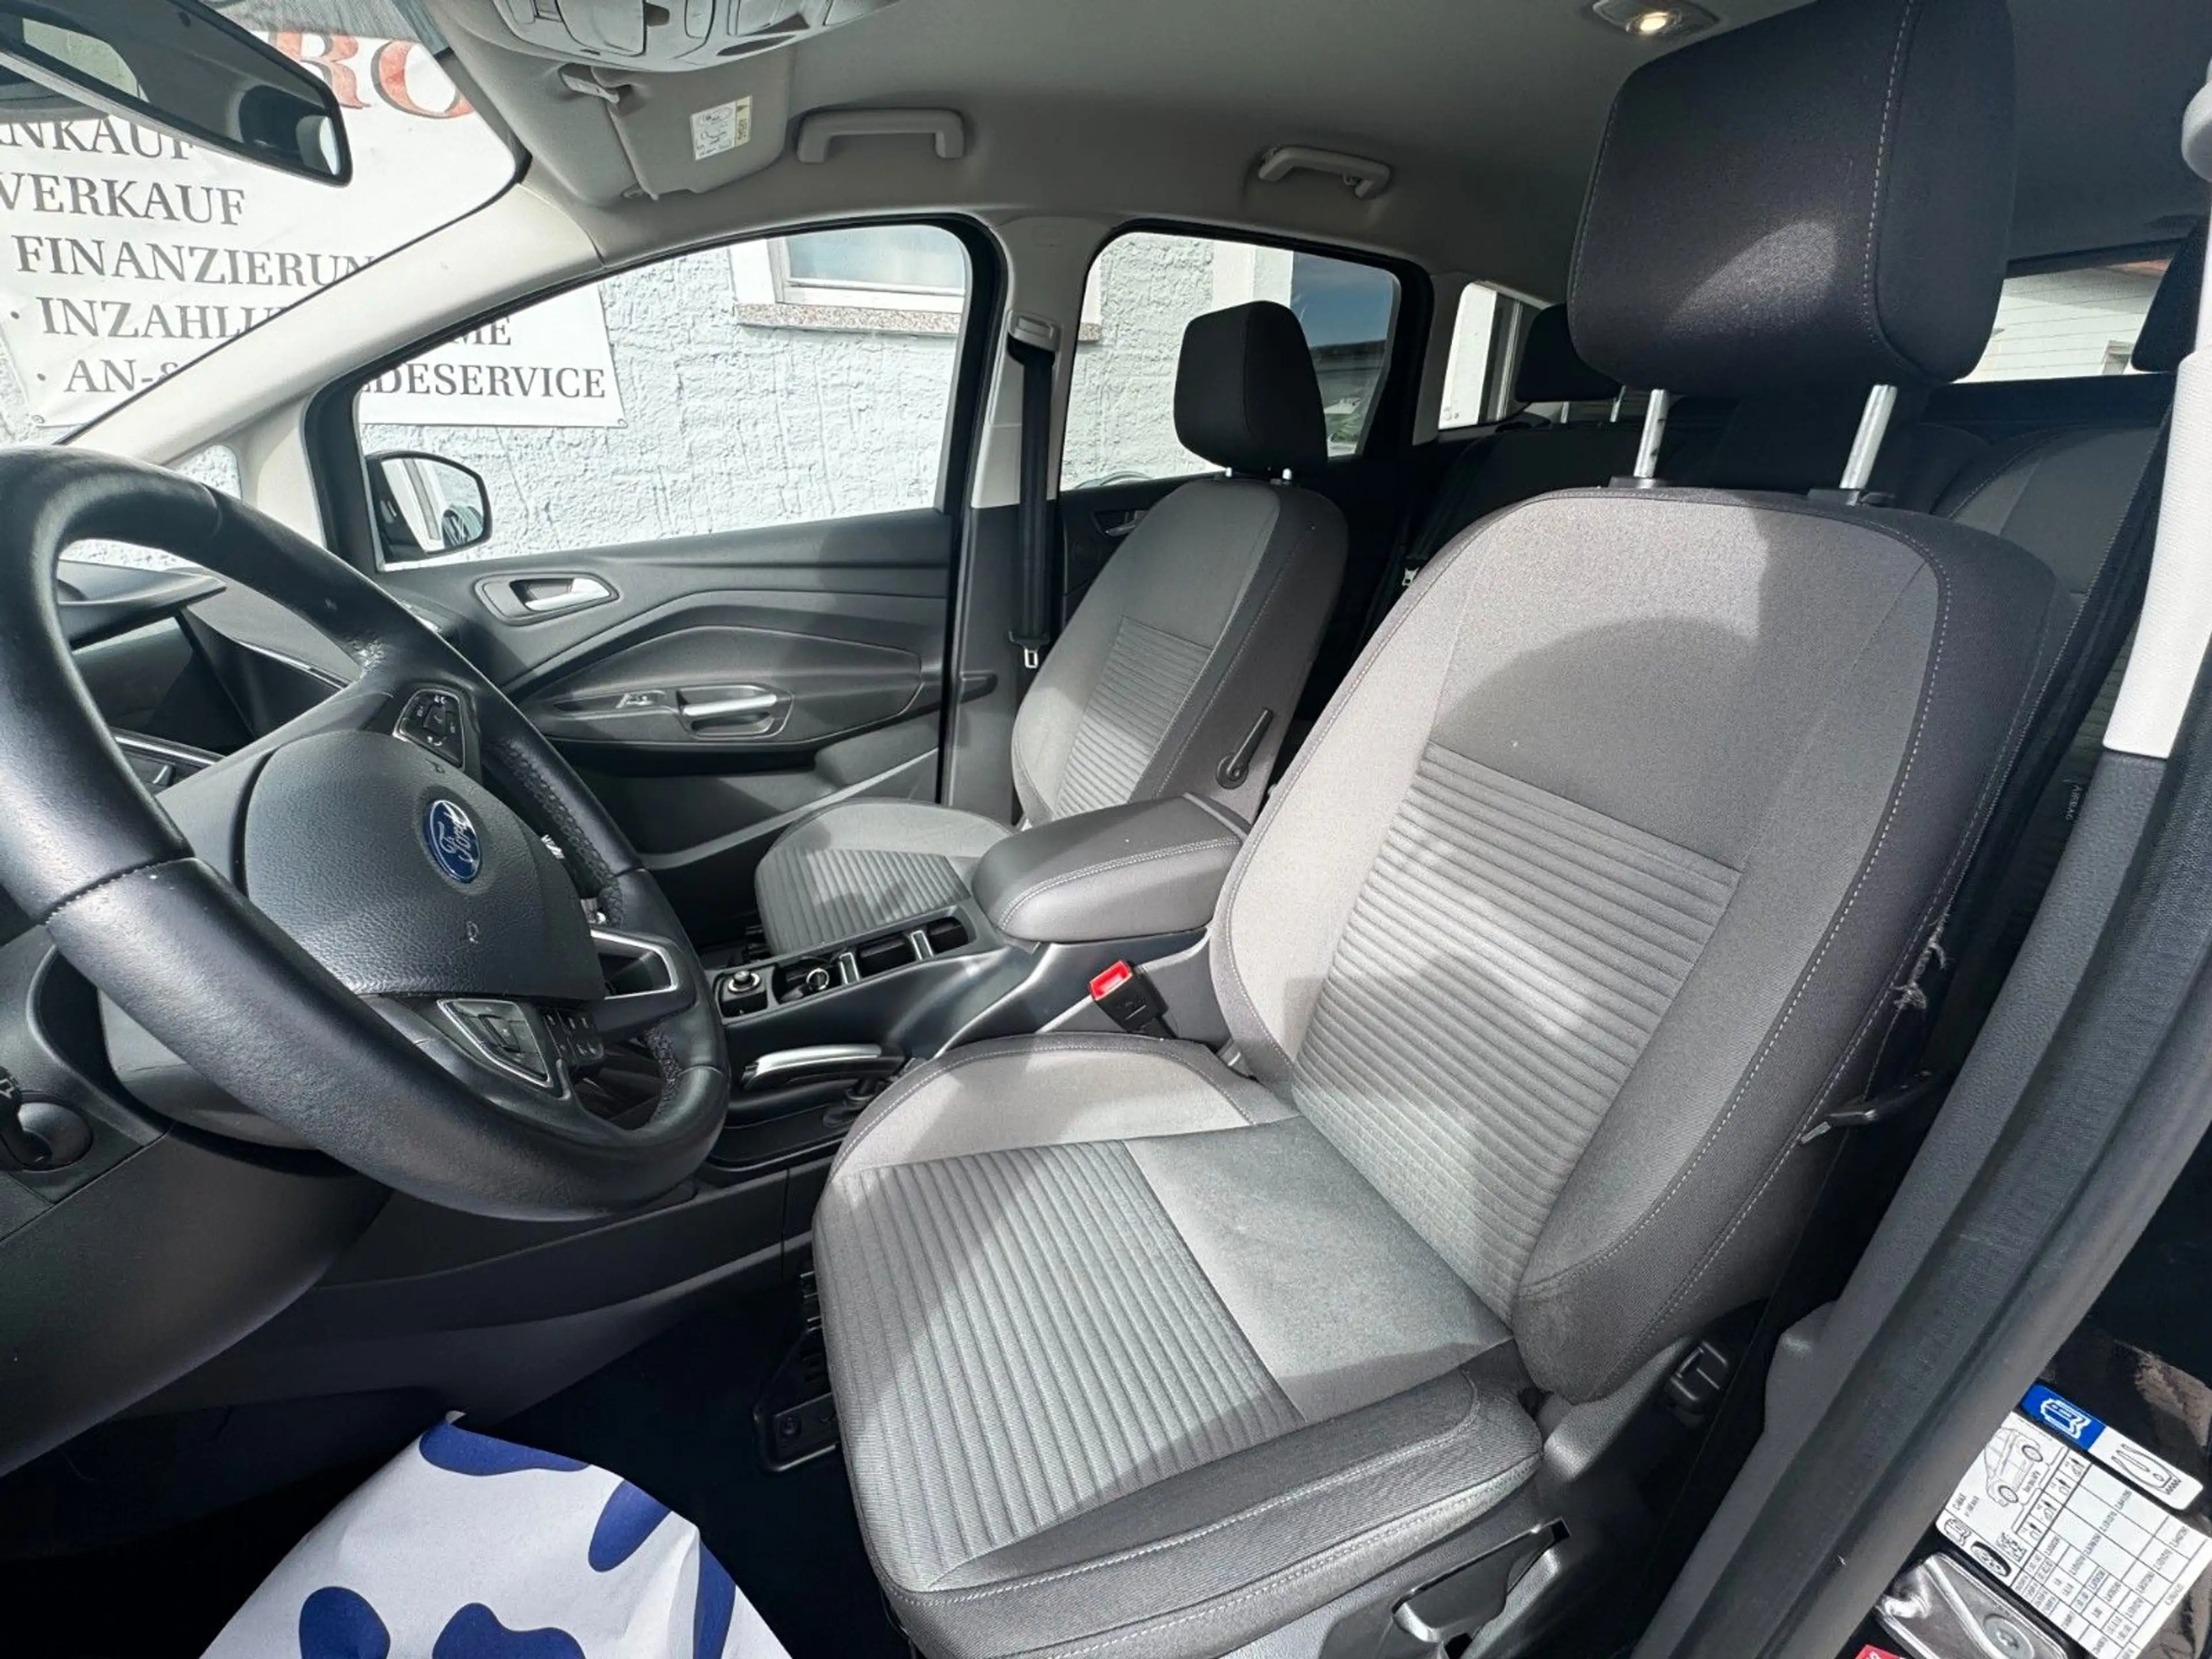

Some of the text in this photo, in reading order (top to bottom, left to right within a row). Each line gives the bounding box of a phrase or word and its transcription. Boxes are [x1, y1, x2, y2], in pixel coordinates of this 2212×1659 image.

[0, 118, 195, 160] NKAU
[0, 173, 245, 226] VERKAUF
[362, 363, 605, 398] DESERVICE
[437, 811, 474, 862] Ford
